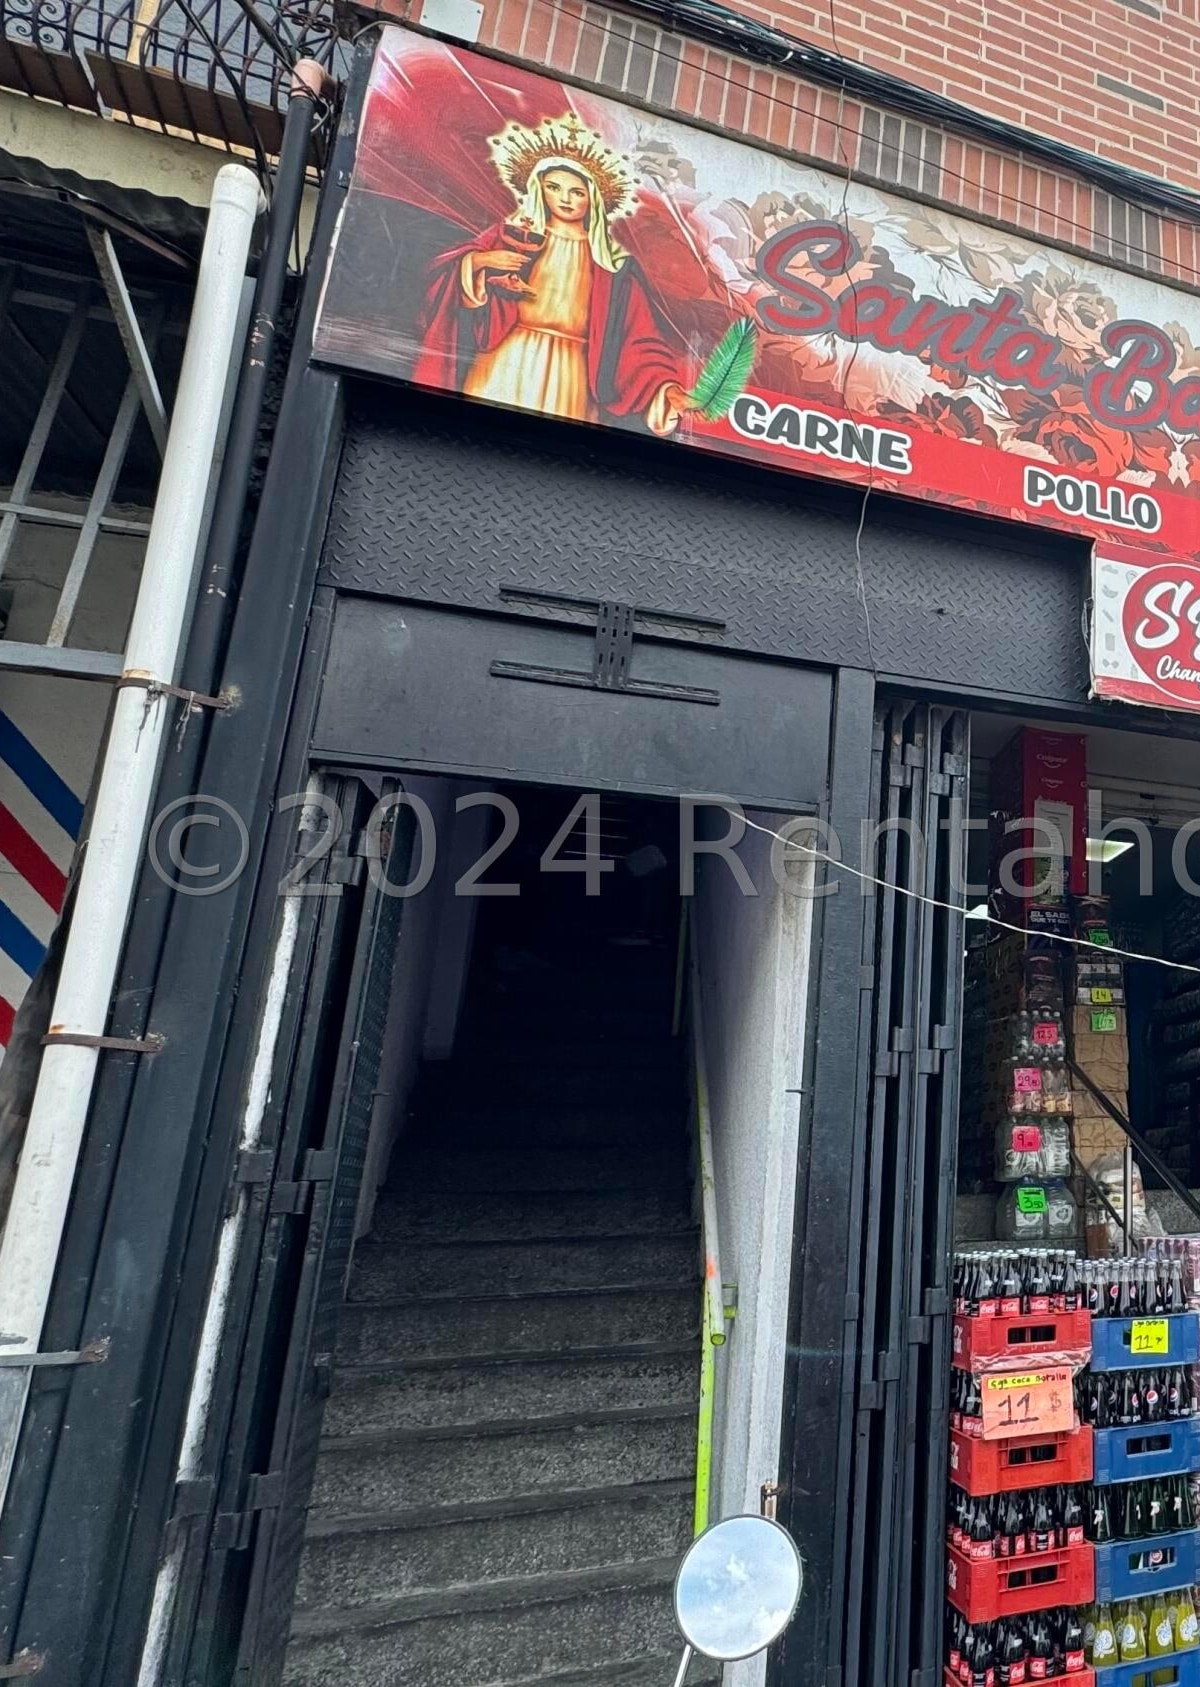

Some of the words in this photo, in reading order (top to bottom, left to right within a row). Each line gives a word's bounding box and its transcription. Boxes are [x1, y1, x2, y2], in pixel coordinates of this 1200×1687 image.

[755, 220, 1063, 392] Santa
[729, 395, 913, 475] CARNE
[1023, 466, 1163, 533] POLLO
